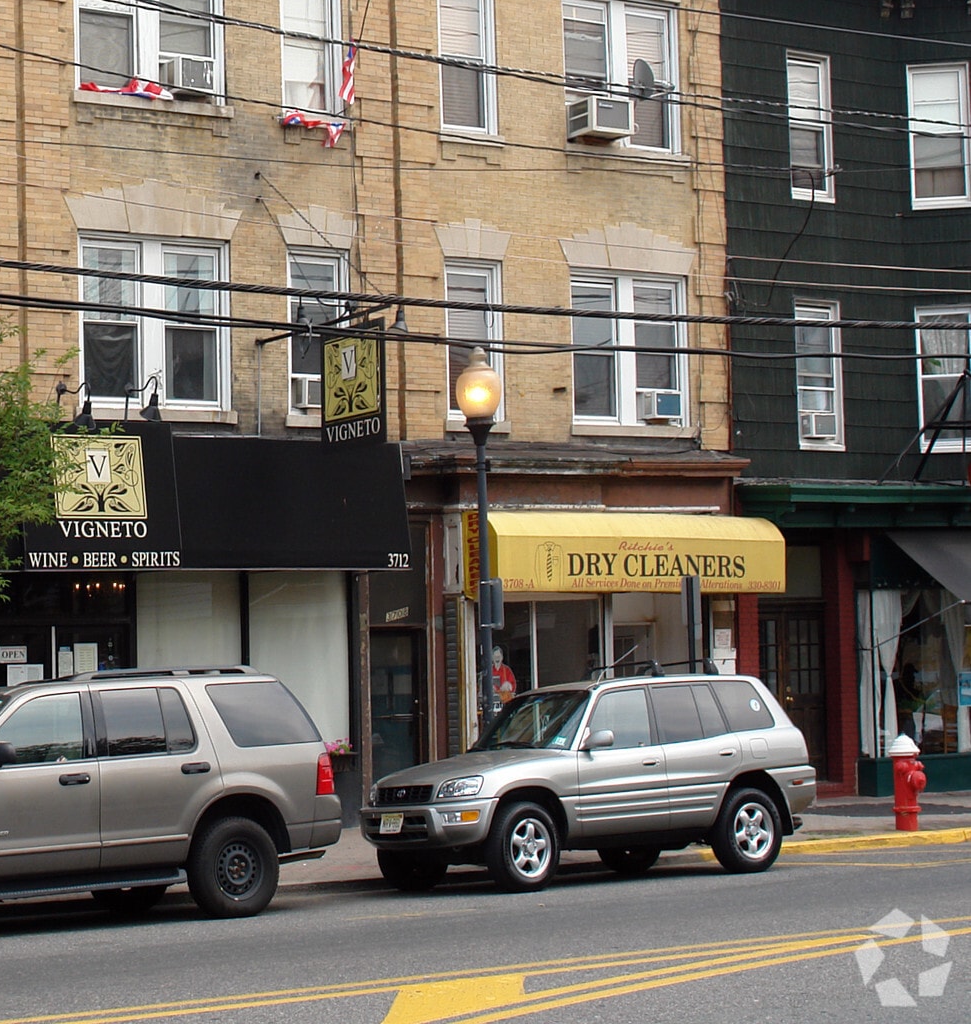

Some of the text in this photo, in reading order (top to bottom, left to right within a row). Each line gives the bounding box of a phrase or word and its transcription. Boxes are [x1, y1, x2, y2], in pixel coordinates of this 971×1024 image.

[342, 349, 354, 374] V
[326, 417, 381, 443] VIGNETO
[88, 455, 107, 478] V
[59, 521, 148, 538] VIGNETO
[618, 540, 674, 552] Ritchie's
[28, 551, 181, 568] WINE BEER SPIRITS
[388, 553, 409, 568] 3712
[567, 553, 746, 578] DRY CLEANERS
[572, 578, 584, 588] All
[586, 578, 619, 588] Services
[620, 578, 641, 588] Done
[701, 578, 743, 589] Alterations
[748, 580, 781, 590] 330-8301
[1, 650, 25, 659] OPEN
